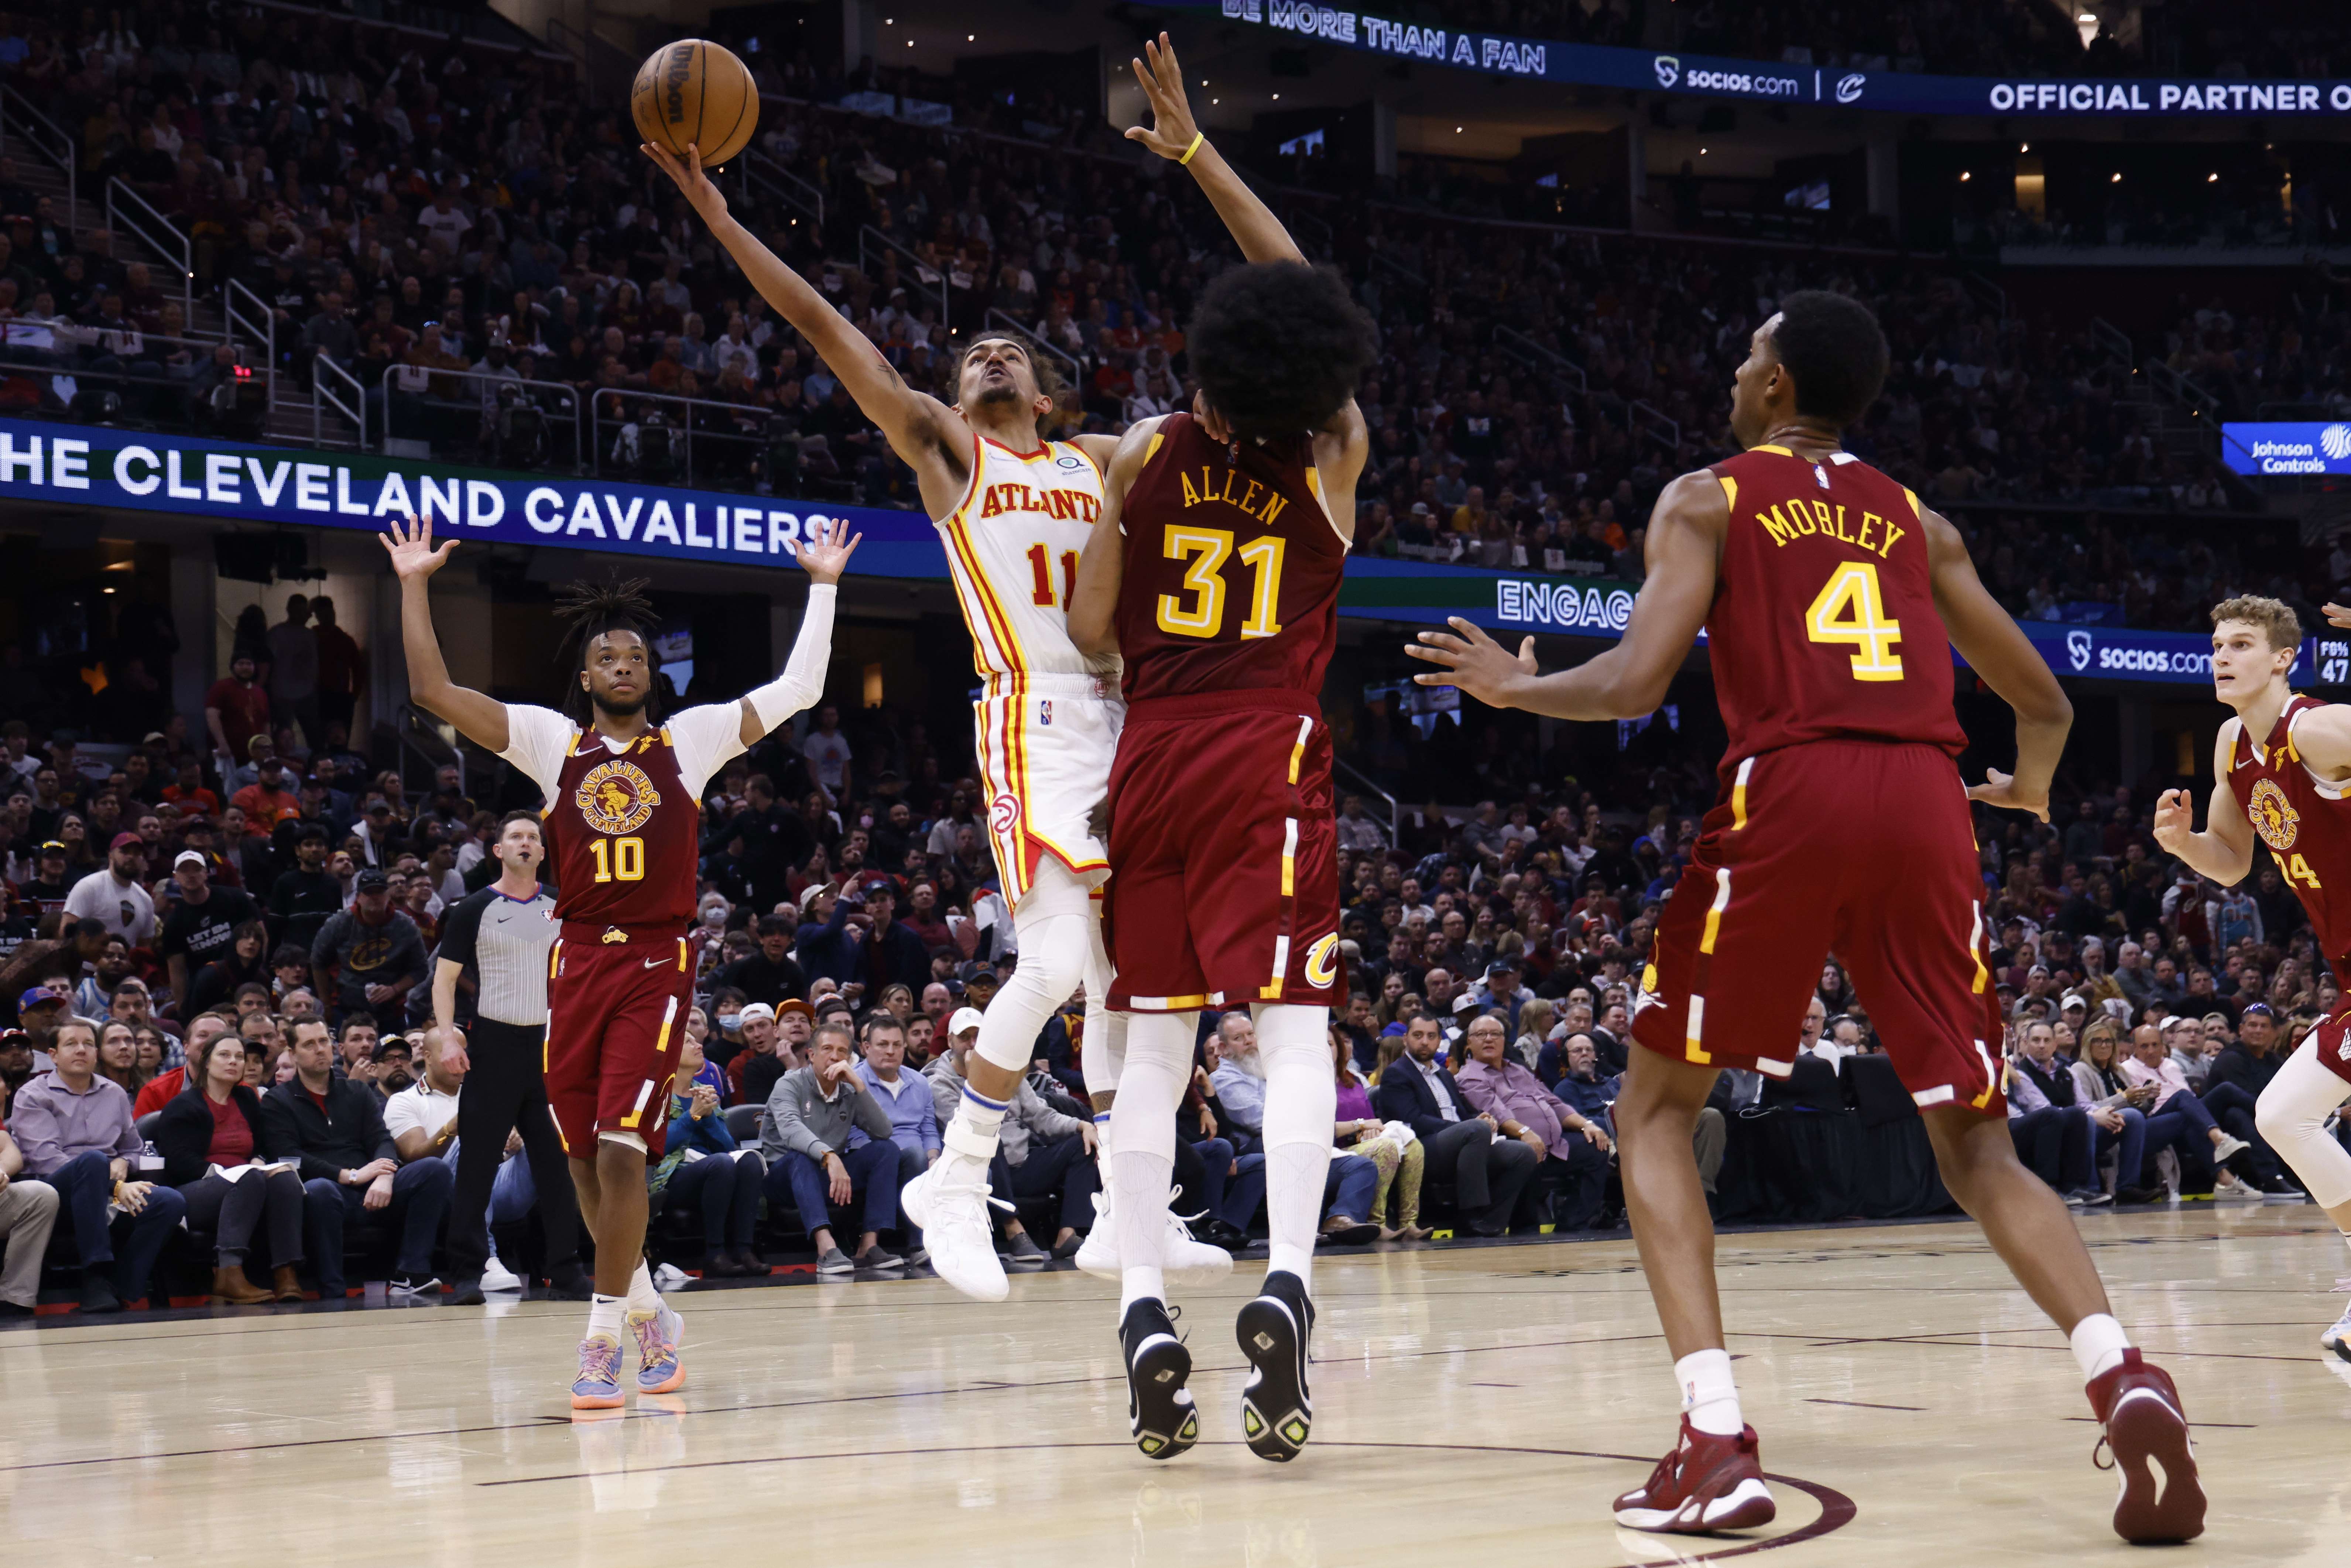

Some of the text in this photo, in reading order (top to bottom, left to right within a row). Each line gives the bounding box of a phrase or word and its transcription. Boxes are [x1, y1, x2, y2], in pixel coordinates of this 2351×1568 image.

[1223, 0, 1545, 74] BE MORE THAN A FAN
[1990, 84, 2150, 110] OFFICIAL
[2160, 85, 2320, 110] PARTNER
[2251, 440, 2313, 458] Johnson
[2262, 456, 2326, 473] Controls
[113, 445, 506, 527] CLEVELAND
[524, 486, 832, 556] CAVALIERS
[1181, 466, 1289, 525] ALLEN
[1755, 498, 1905, 559] MOBLEY
[1025, 542, 1080, 614] 11
[1156, 524, 1286, 640] 31
[1497, 579, 1639, 631] ENGAG
[1805, 561, 1904, 681] 4
[2320, 641, 2349, 658] FG%
[2321, 659, 2349, 683] 47
[576, 760, 661, 809] CAVALIERS
[2248, 778, 2300, 824] CAVALIERS
[583, 805, 652, 834] CLEVELAND
[2256, 822, 2297, 850] CLEVELAND
[589, 837, 644, 882] 10
